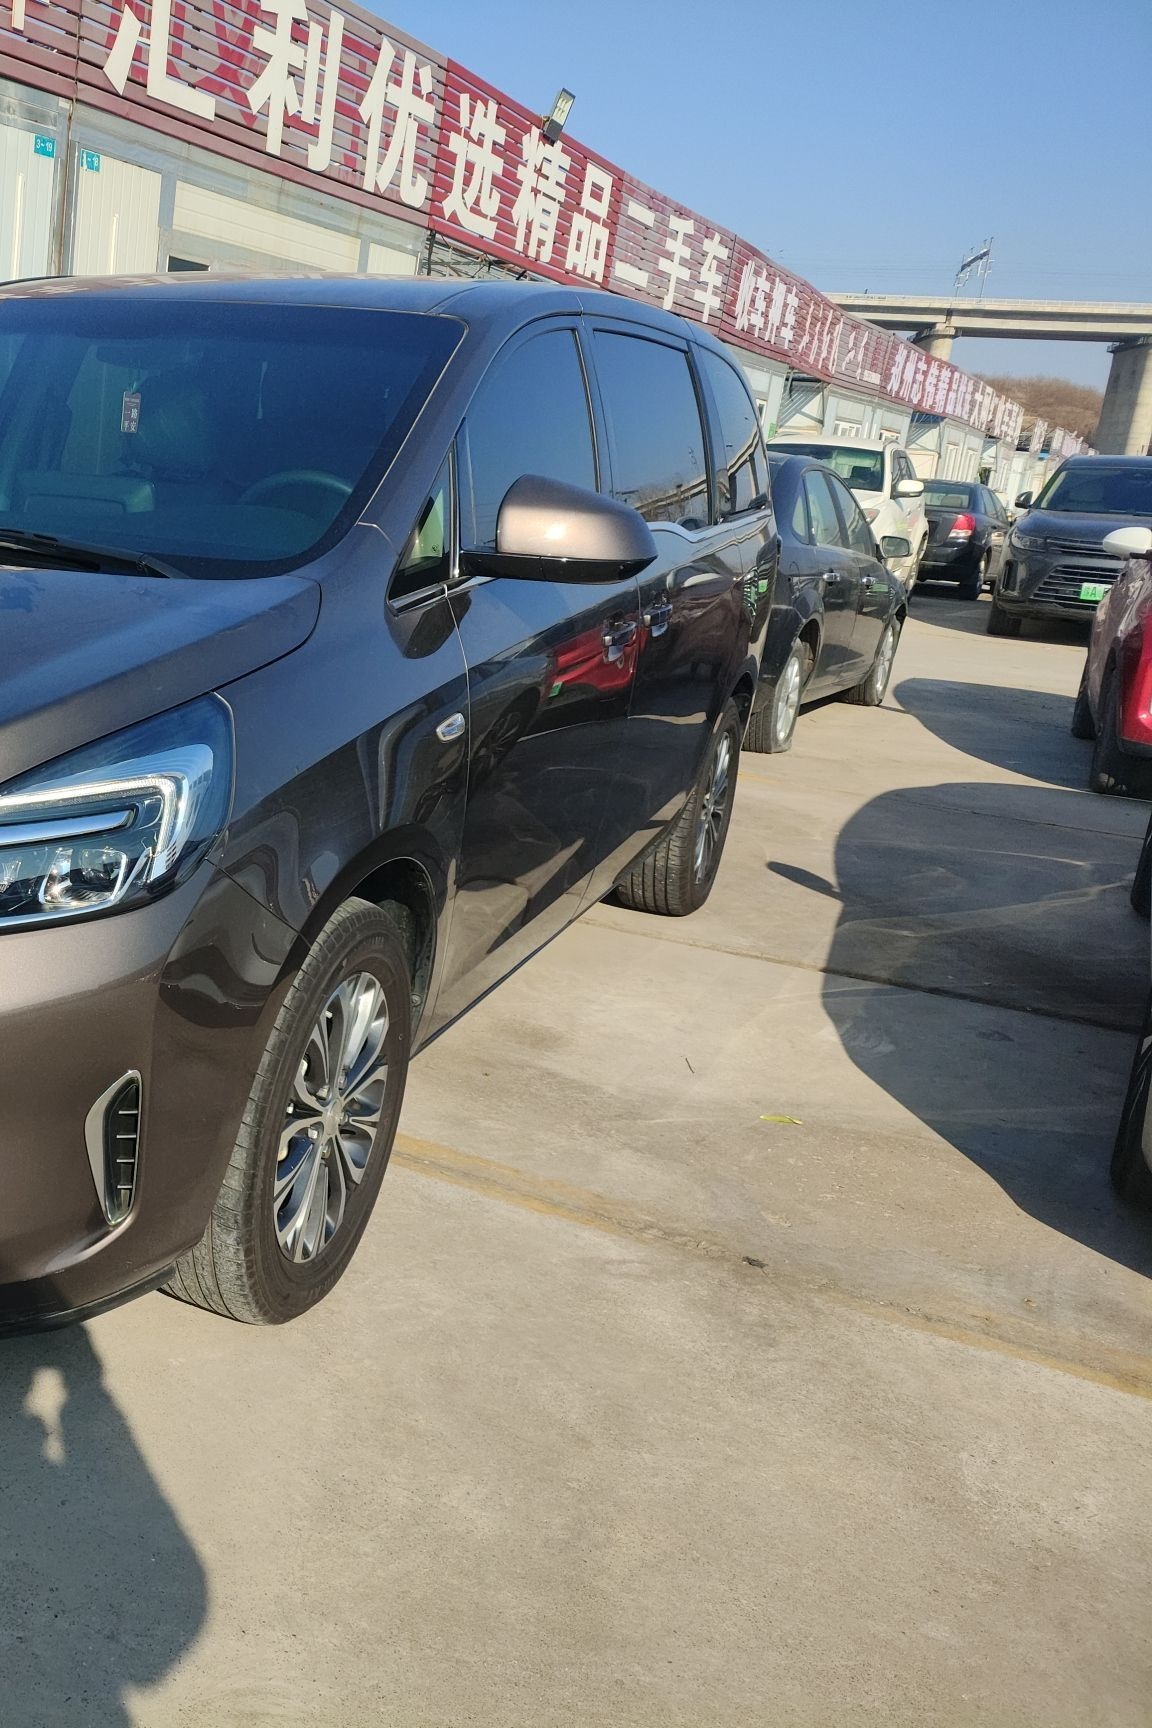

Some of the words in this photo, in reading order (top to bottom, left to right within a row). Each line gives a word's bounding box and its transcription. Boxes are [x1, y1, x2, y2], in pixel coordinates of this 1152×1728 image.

[11, 0, 729, 323] 汇利优选精品二手车
